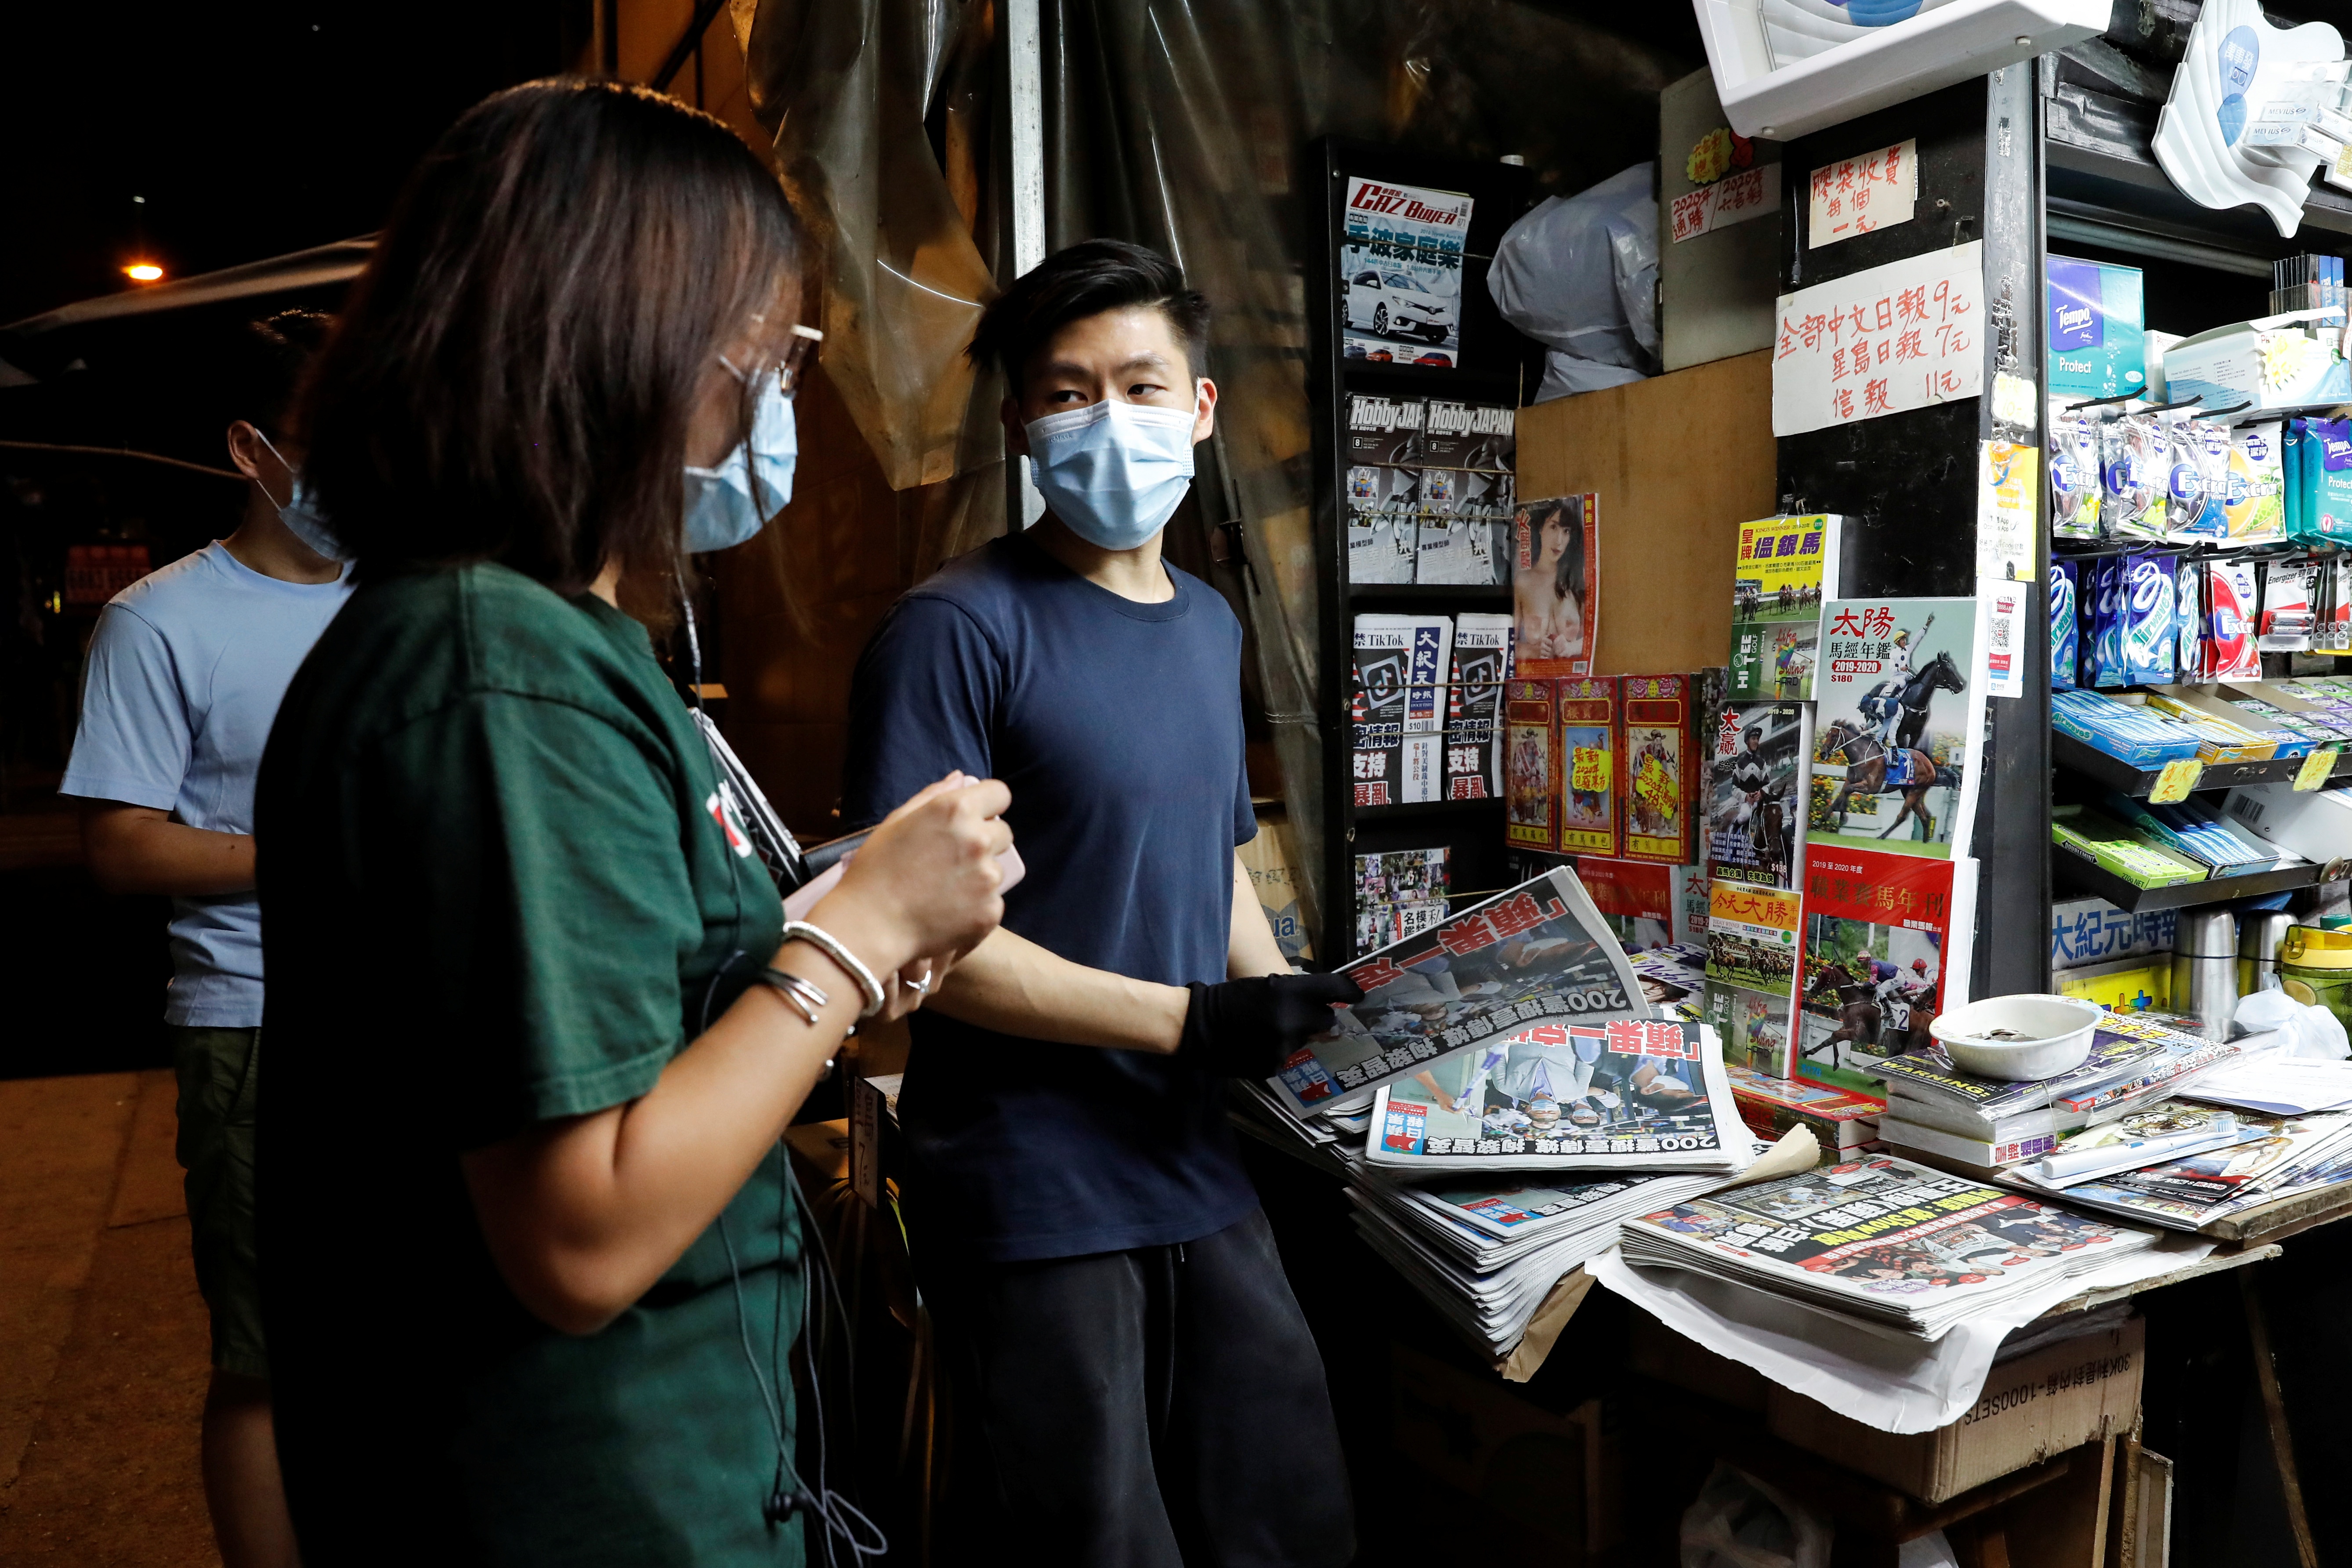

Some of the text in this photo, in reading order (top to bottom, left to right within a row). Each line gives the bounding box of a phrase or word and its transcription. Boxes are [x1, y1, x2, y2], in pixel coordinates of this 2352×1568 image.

[2225, 42, 2254, 70] 萬事發
[1813, 145, 1902, 201] 膠袋收費
[1674, 186, 1714, 216] 2020年
[1827, 191, 1871, 218] 每個
[1832, 218, 1877, 234] 一元
[2055, 304, 2092, 329] Tempo
[2059, 356, 2092, 373] Protect
[1832, 379, 1896, 419] 信報
[1354, 438, 1361, 447] 8
[2323, 438, 2350, 455] Tempo
[2059, 463, 2096, 488] Extra
[2178, 471, 2226, 494] Extra
[2227, 479, 2278, 499] Extra
[1585, 500, 1593, 523] 警告
[1740, 529, 1754, 561] 皇牌
[1753, 532, 1823, 559] 搵銀馬
[2268, 572, 2298, 585] Energizer
[1830, 606, 1896, 640] 太陽
[2131, 585, 2173, 647] Airwaves
[1354, 633, 1404, 647] 禁 TikTok
[1456, 632, 1500, 646] 禁 TikTok
[1776, 628, 1797, 642] Like
[1737, 634, 1756, 688] HI TEE
[1829, 641, 1891, 659] 馬經年鑑
[1779, 660, 1805, 679] Swing
[1835, 661, 1878, 673] 2019-2020
[1831, 674, 1853, 683] $180
[2052, 712, 2091, 739] Airwaves
[1353, 751, 1387, 779] 支持
[1448, 747, 1479, 773] 支持
[1718, 760, 1737, 771] 綜合本
[2063, 841, 2096, 862] DOUBLEMINT
[1748, 870, 1774, 884] 先睹為快
[1771, 863, 1787, 873] $138
[2134, 878, 2145, 888] NET
[1686, 899, 1710, 915] 馬經
[1810, 876, 1946, 918] 職業賽馬年刊
[1712, 893, 1788, 927] 今天大勝
[1789, 905, 1798, 925] 年鑑
[1898, 1009, 1909, 1031] 2
[1882, 1061, 1992, 1098] WARNING:
[1386, 1113, 1404, 1136] 蘋果
[1406, 1116, 1424, 1139] 日報
[1427, 1135, 1717, 1155] 200警搜壹傳媒 拘黎智英
